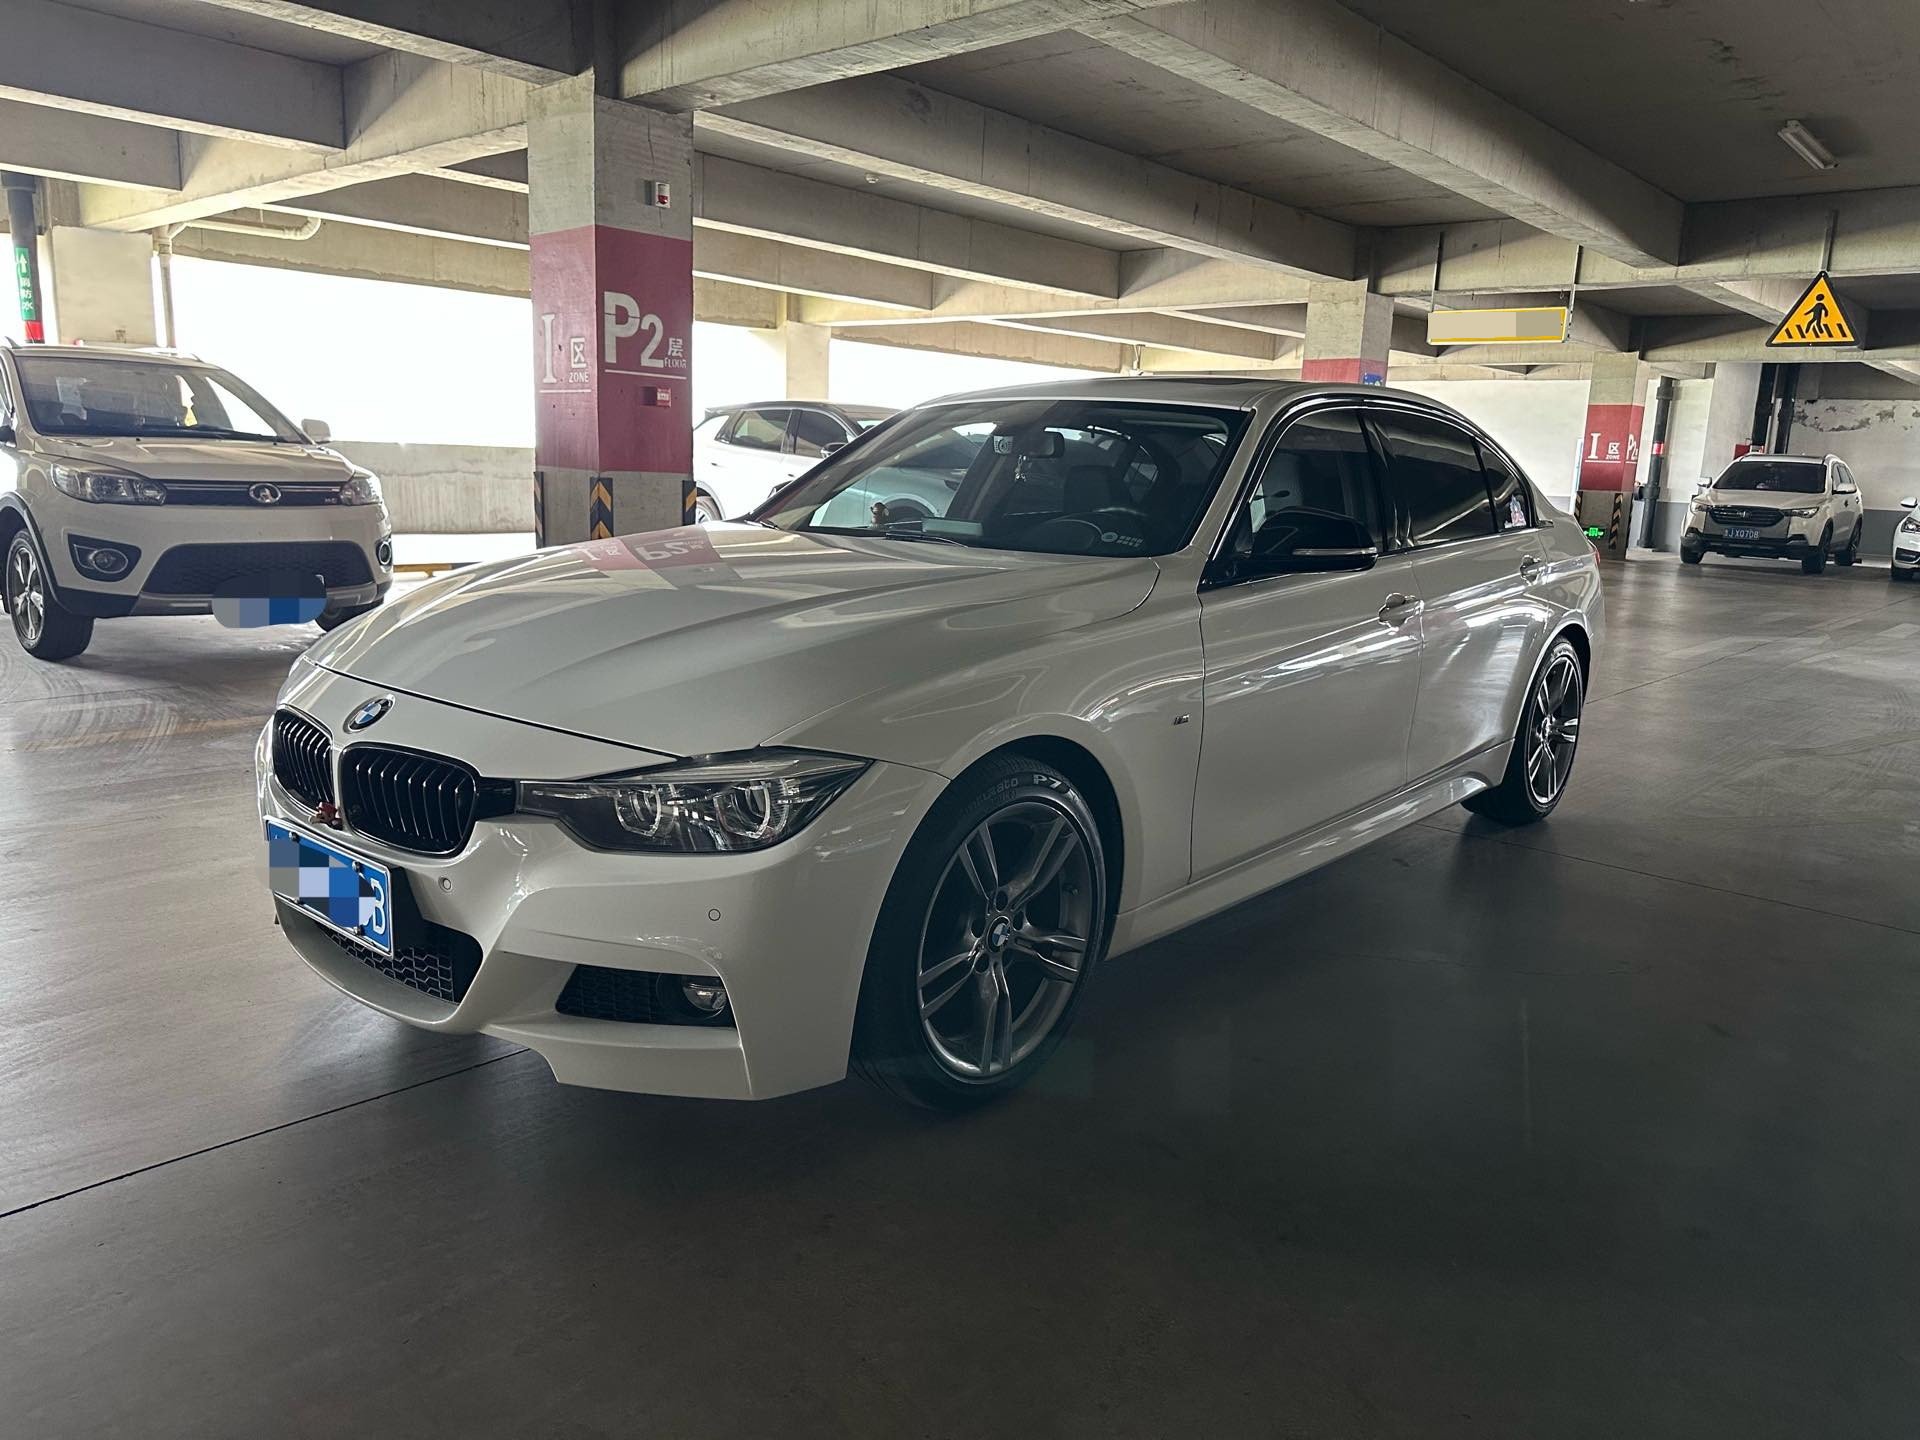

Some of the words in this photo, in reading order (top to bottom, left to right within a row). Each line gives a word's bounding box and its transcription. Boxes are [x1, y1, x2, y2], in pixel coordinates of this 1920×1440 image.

[604, 291, 664, 368] P2
[668, 337, 684, 358] 层
[542, 314, 557, 383] I
[570, 337, 587, 369] 区
[664, 357, 687, 369] FLOOR
[568, 371, 590, 383] ZONE
[1588, 433, 1601, 459] I
[1608, 442, 1621, 455] 区
[1033, 774, 1062, 789] P7
